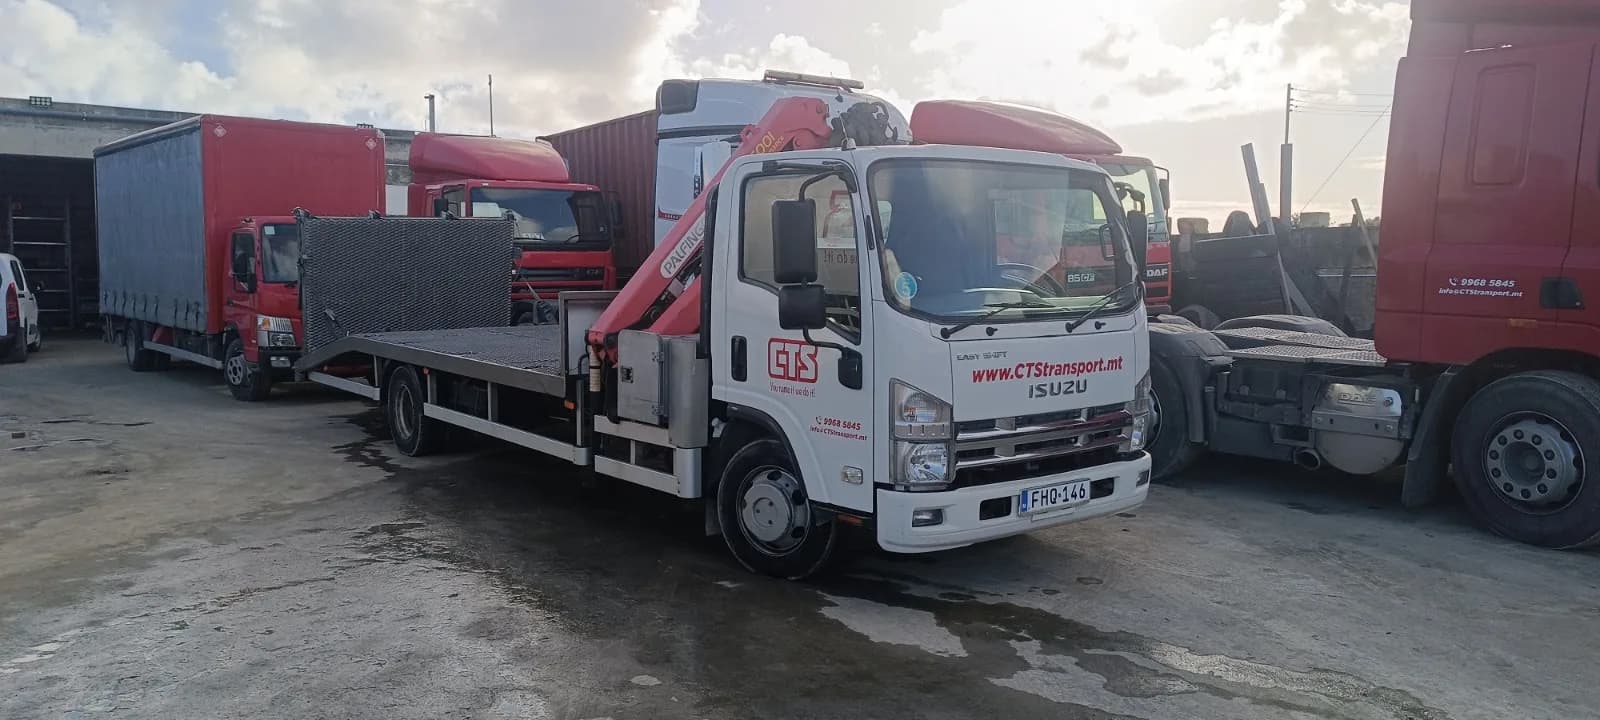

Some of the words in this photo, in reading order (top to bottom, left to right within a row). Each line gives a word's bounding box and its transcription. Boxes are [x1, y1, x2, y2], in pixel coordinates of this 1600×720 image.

[1146, 268, 1168, 277] DAF
[1461, 278, 1486, 287] 9968
[1488, 279, 1515, 288] 5845
[768, 338, 818, 383] CTS
[972, 355, 1123, 384] www.CTStransport.mt
[1028, 379, 1088, 399] ISUZU
[823, 417, 841, 428] 9968
[842, 420, 861, 431] 5845
